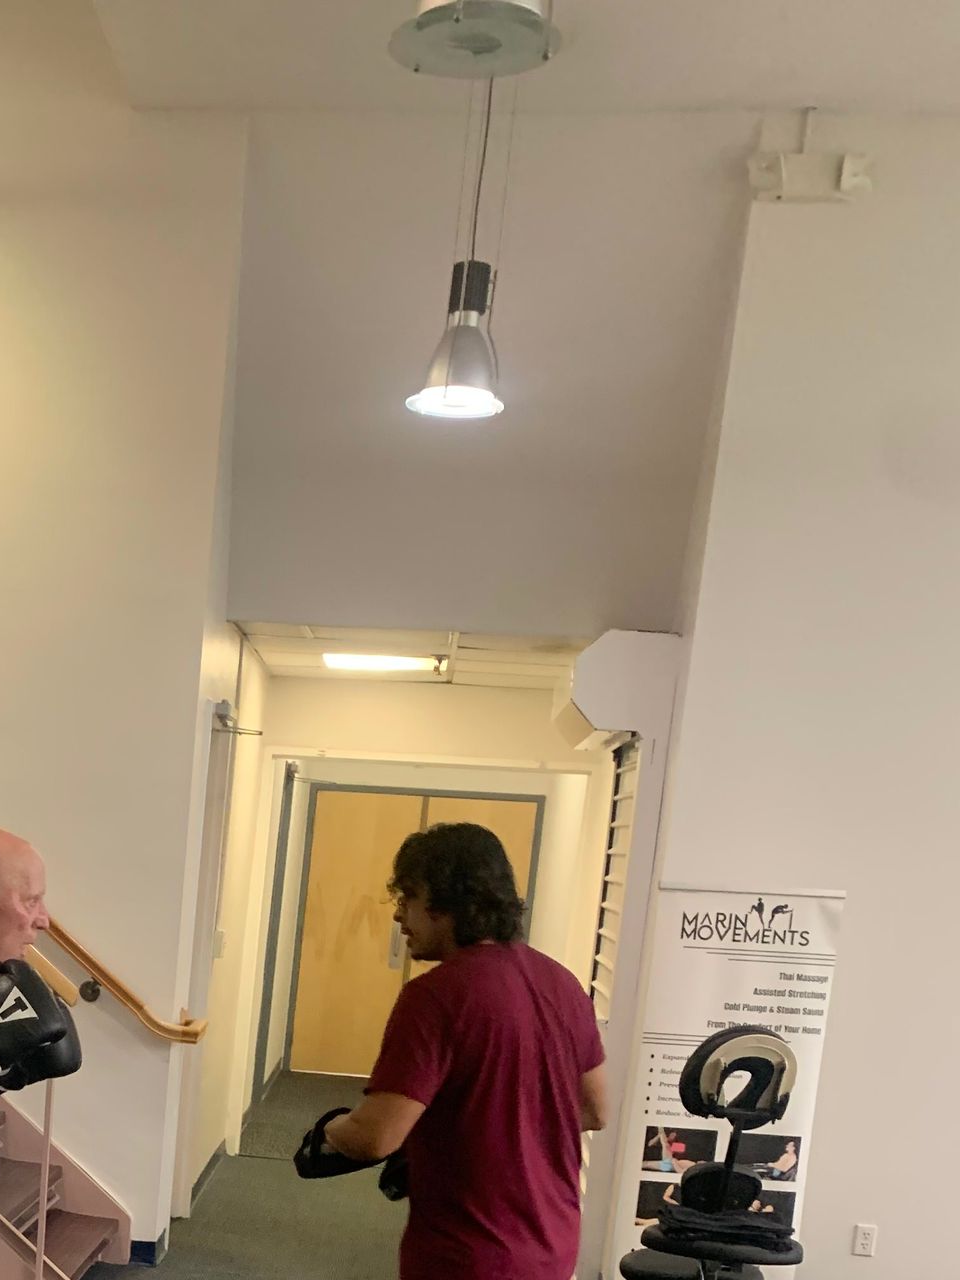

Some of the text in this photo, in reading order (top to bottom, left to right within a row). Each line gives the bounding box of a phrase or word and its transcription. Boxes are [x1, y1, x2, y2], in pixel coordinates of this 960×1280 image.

[682, 912, 748, 929] MARIN
[681, 924, 810, 946] MOVEMENTS
[779, 972, 828, 984] Thai Massage
[753, 987, 827, 1000] Assisted Stretching
[724, 1002, 741, 1011] Cold
[742, 1003, 767, 1014] Plunge
[776, 1005, 801, 1015] Steam
[802, 1007, 824, 1016] Sauna
[707, 1020, 726, 1028] From
[784, 1025, 800, 1034] Your
[802, 1026, 822, 1035] Home
